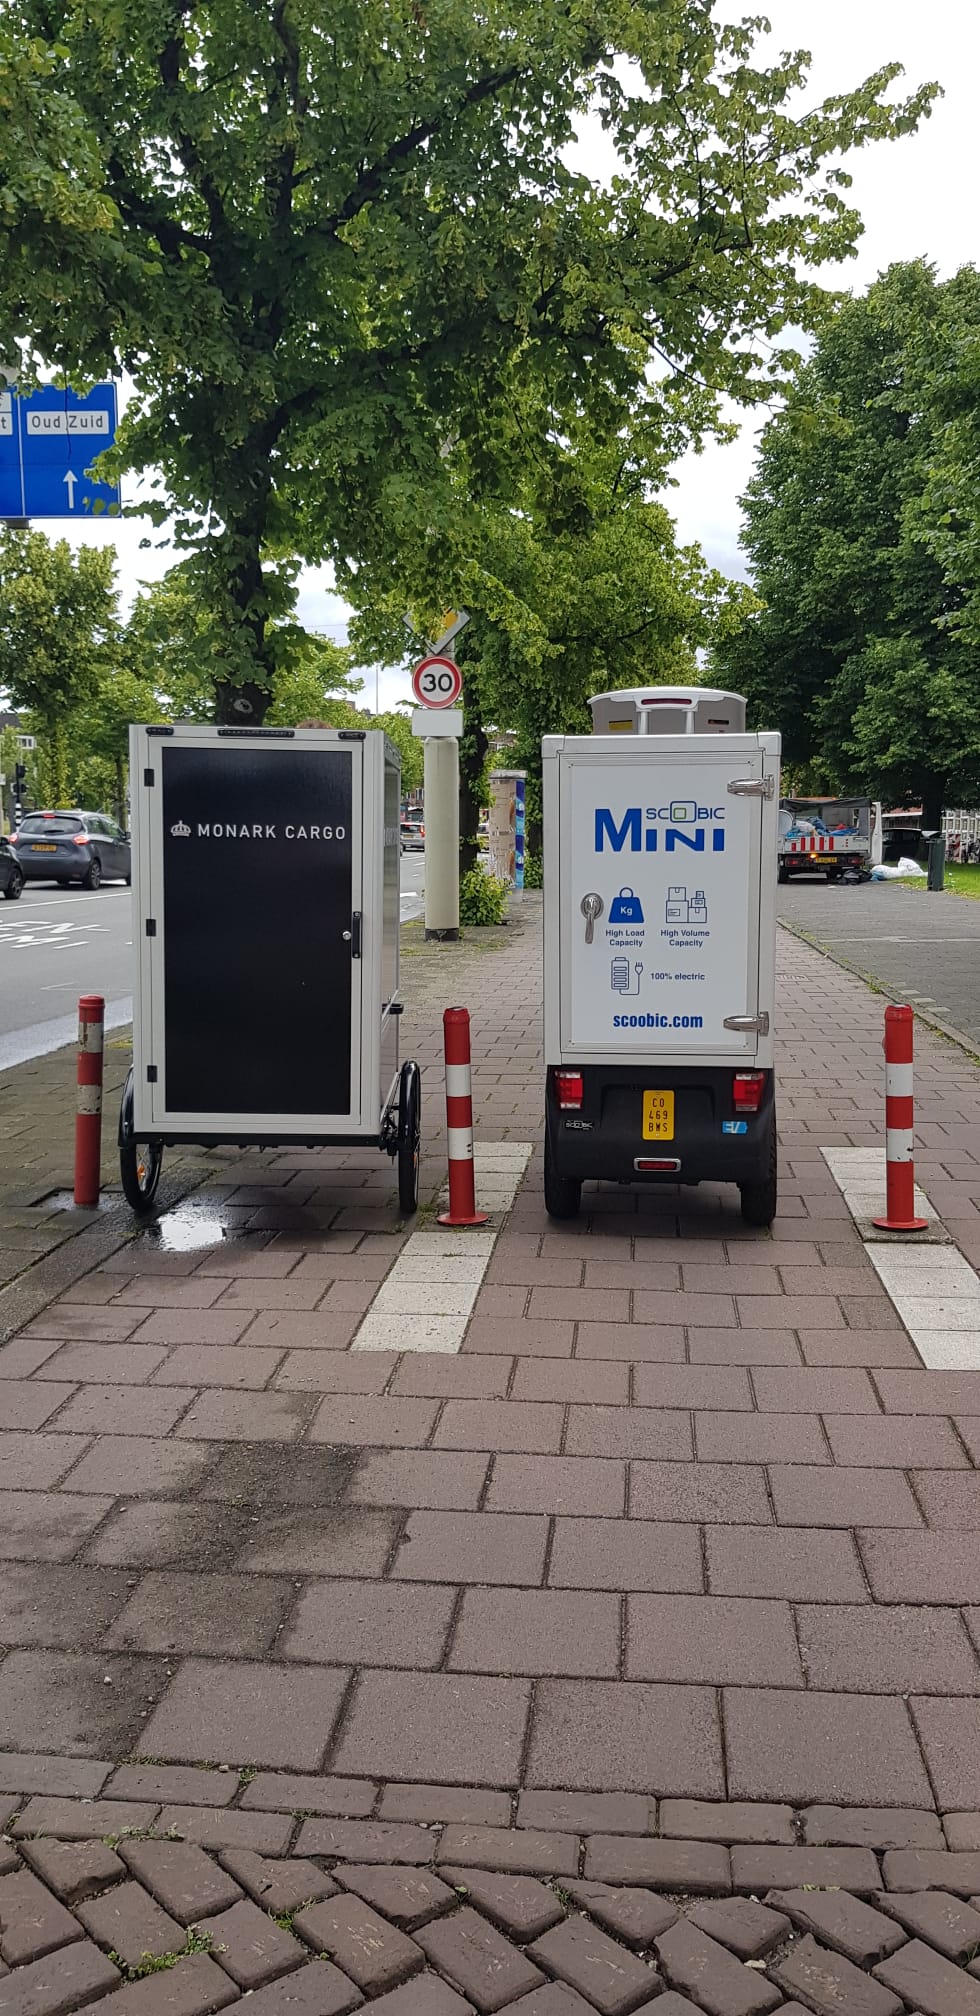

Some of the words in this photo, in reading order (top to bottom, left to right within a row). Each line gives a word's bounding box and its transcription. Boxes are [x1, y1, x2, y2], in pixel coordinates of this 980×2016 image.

[31, 416, 61, 428] Oud
[68, 416, 103, 428] Zuid
[422, 673, 453, 692] 30
[198, 823, 276, 838] MONARK
[284, 825, 346, 840] CARGO
[595, 808, 725, 852] MINI
[620, 906, 633, 916] Kg
[606, 929, 623, 938] High
[625, 929, 645, 937] Load
[660, 929, 678, 938] High
[681, 929, 710, 937] Volume
[609, 939, 643, 947] Capacity
[669, 939, 703, 947] Capacity
[650, 972, 672, 980] 100%
[674, 972, 705, 980] electric
[613, 1013, 703, 1028] scoobic.com
[649, 1110, 668, 1119] 469
